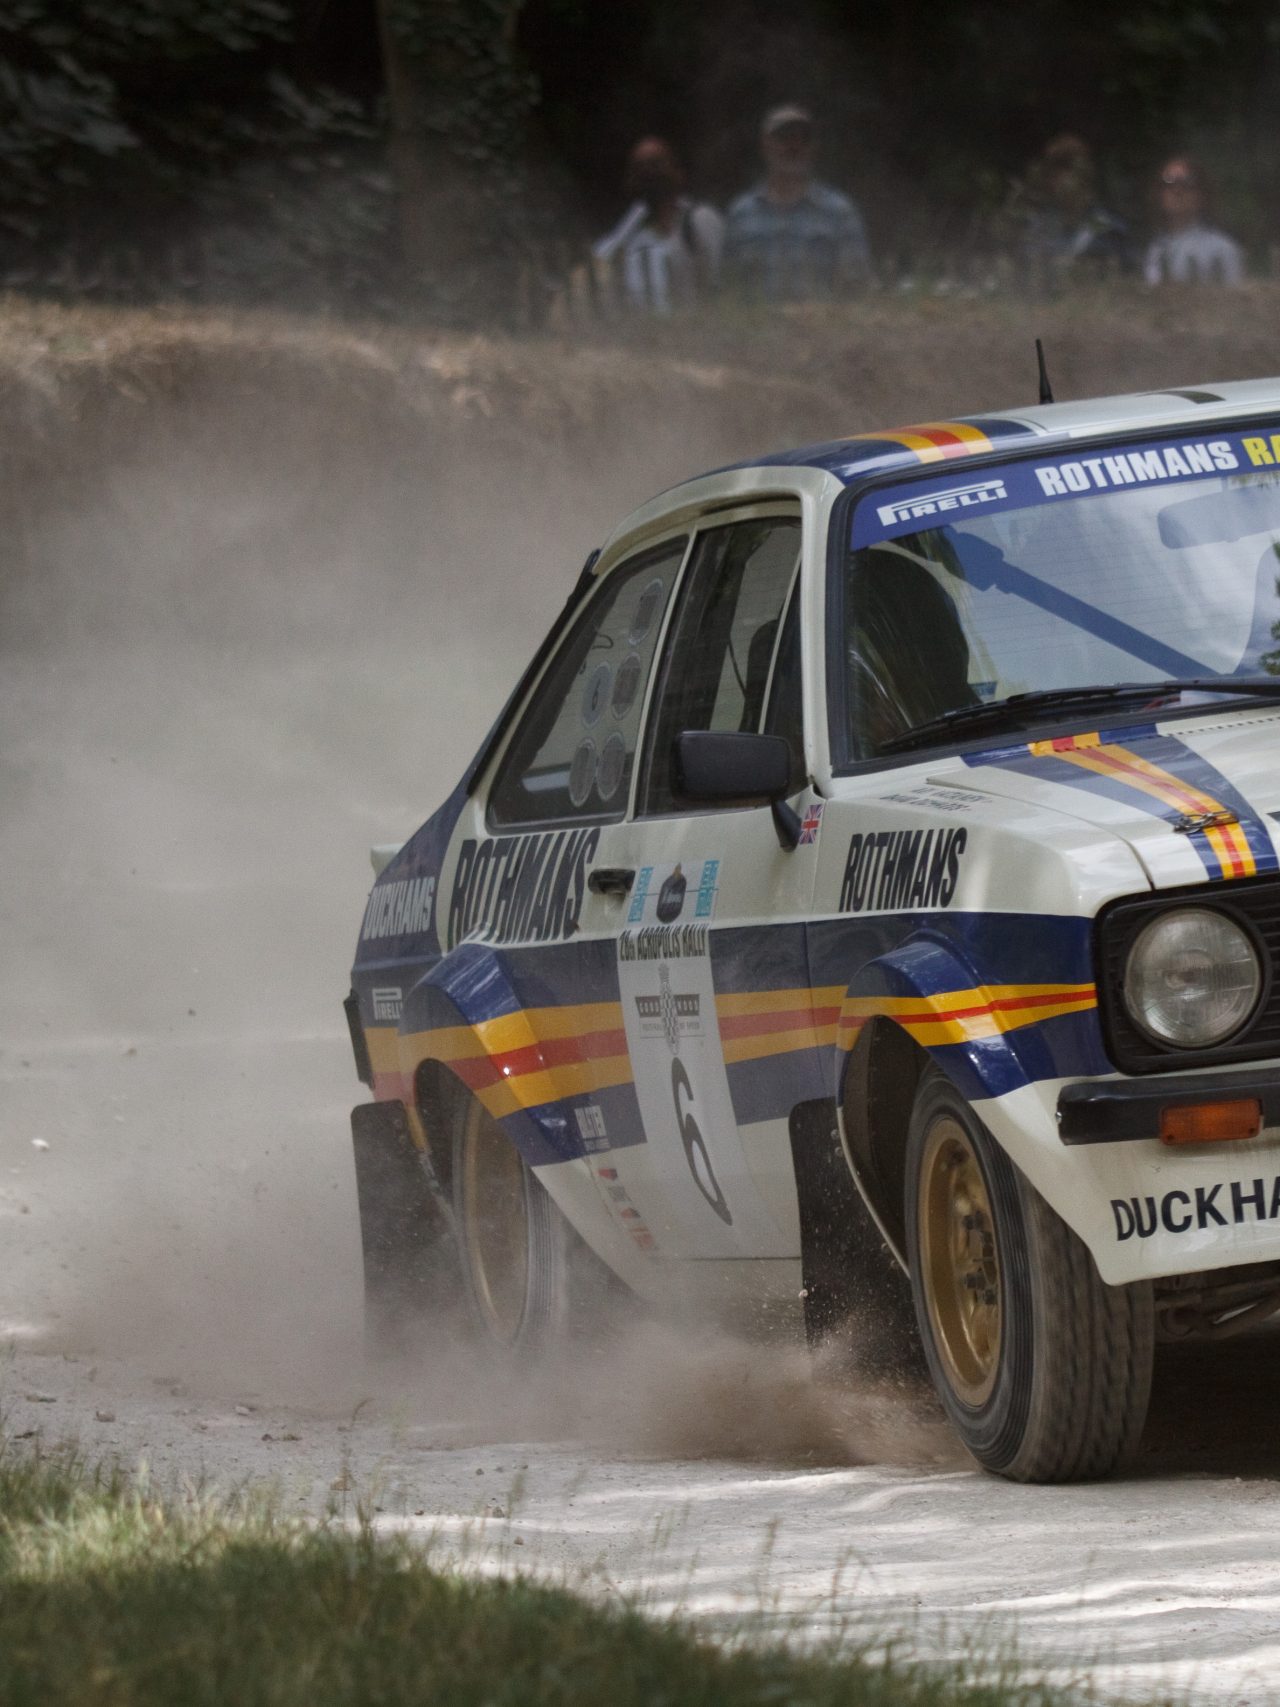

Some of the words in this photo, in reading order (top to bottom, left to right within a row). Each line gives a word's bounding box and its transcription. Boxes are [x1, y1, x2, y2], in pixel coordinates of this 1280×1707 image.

[876, 480, 1008, 526] PIRELLI
[1035, 441, 1239, 496] ROTHMANS
[448, 828, 600, 952] ROTHMANS
[839, 827, 967, 912] ROTHMANS
[363, 876, 435, 940] DUCKHAMS
[671, 1057, 732, 1226] 6
